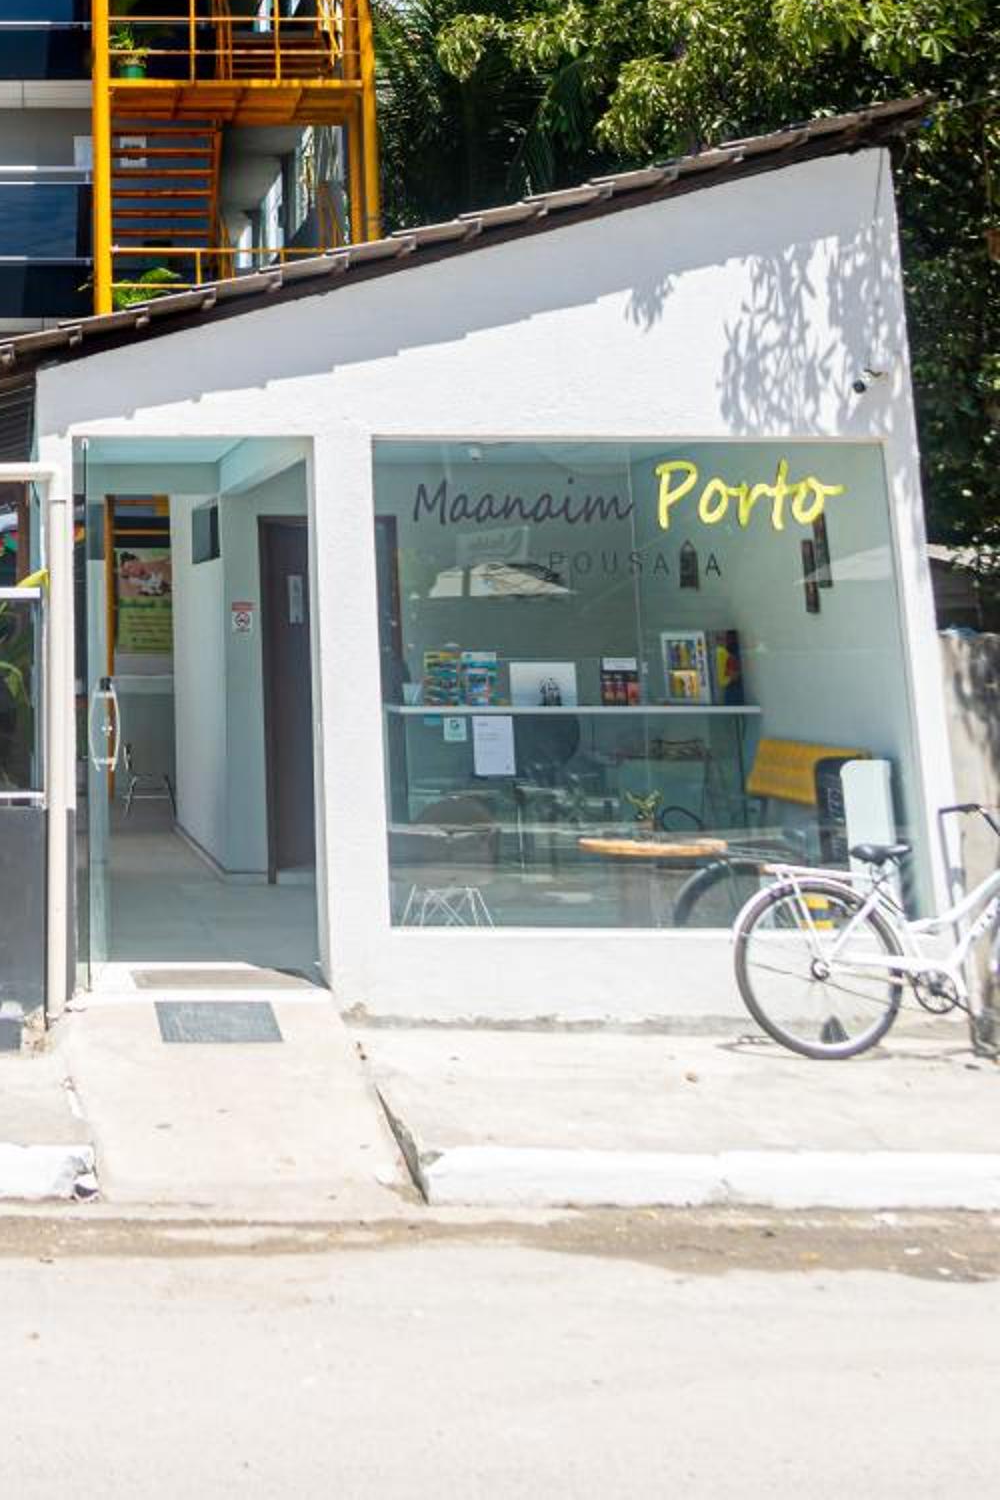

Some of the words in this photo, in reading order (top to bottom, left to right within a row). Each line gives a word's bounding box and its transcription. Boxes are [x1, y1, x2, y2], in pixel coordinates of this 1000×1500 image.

[412, 476, 634, 526] Maanaim
[655, 457, 847, 531] Porto
[548, 549, 724, 578] POUSAA
